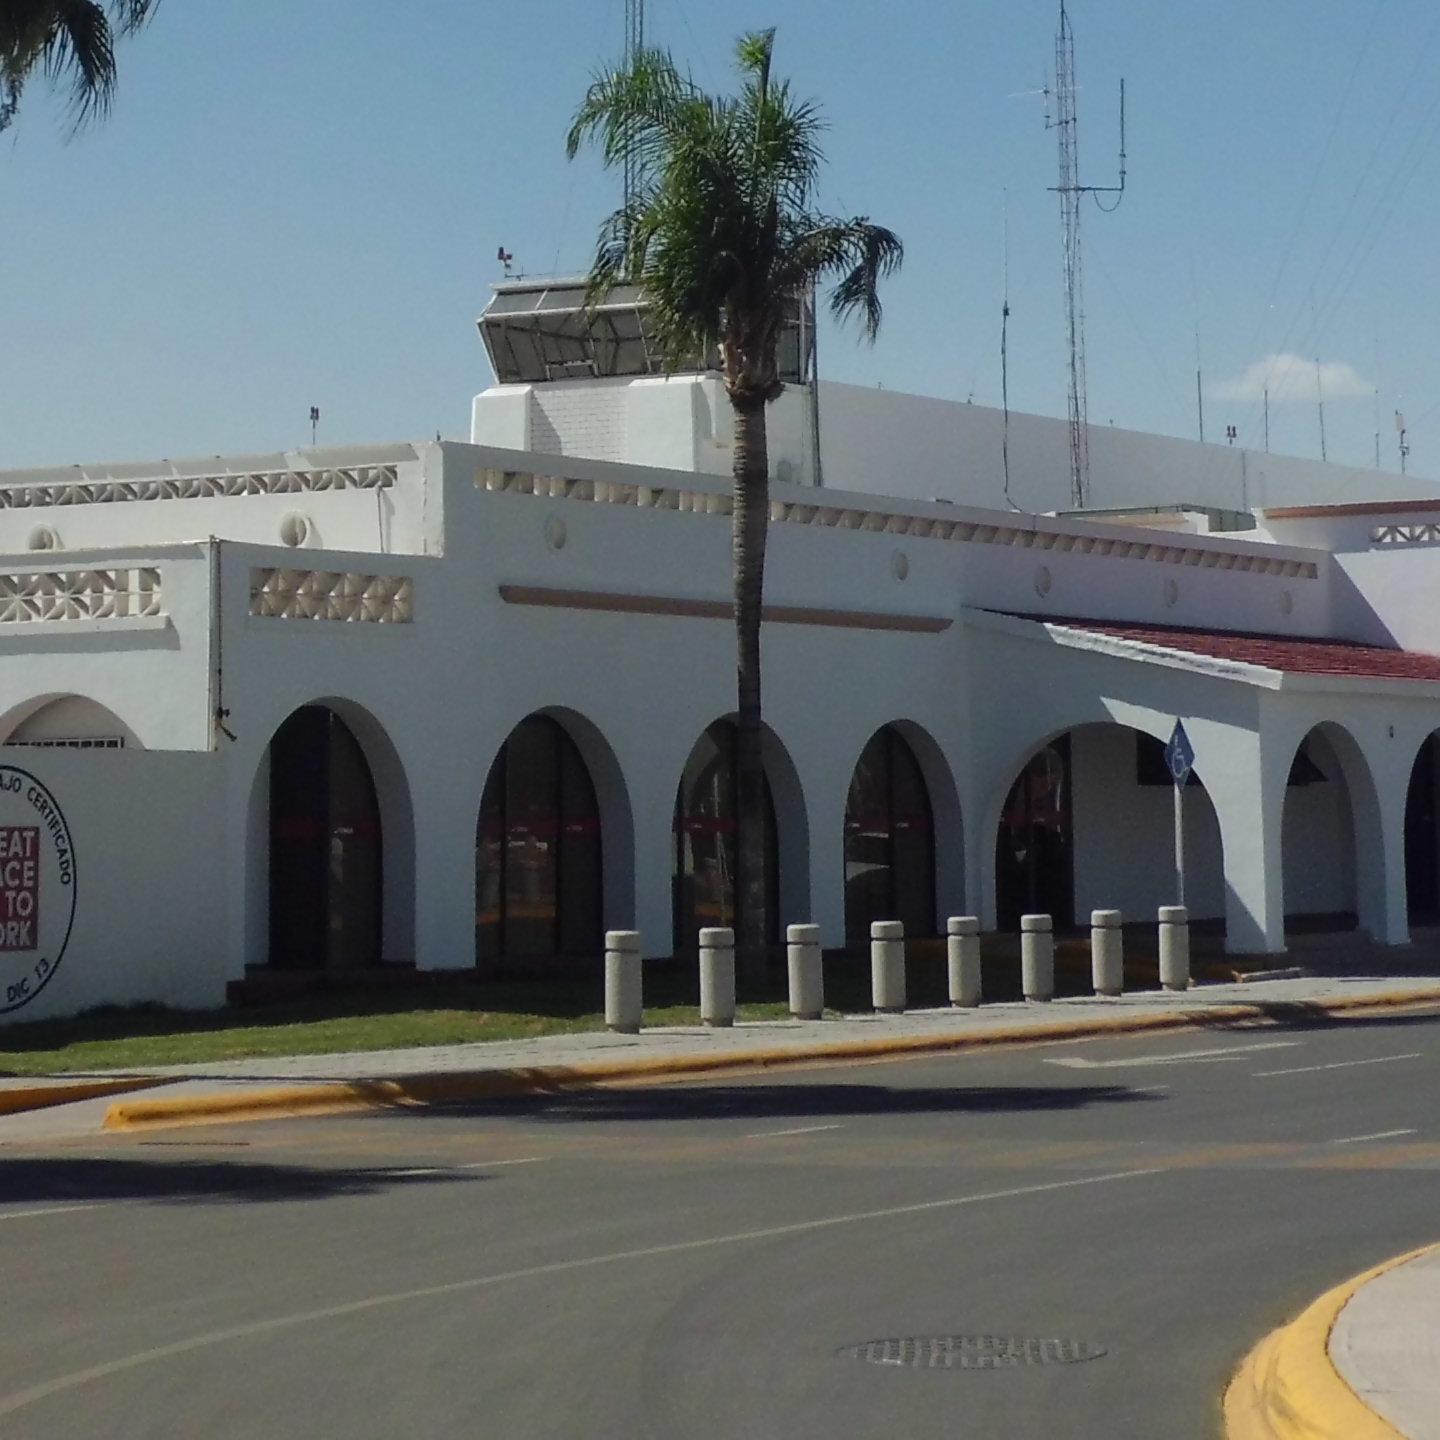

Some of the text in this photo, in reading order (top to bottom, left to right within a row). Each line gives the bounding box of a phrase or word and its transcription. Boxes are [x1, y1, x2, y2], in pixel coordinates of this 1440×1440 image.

[27, 786, 72, 886] CERTIFICADO
[5, 891, 33, 918] TO
[6, 977, 31, 1003] DIC
